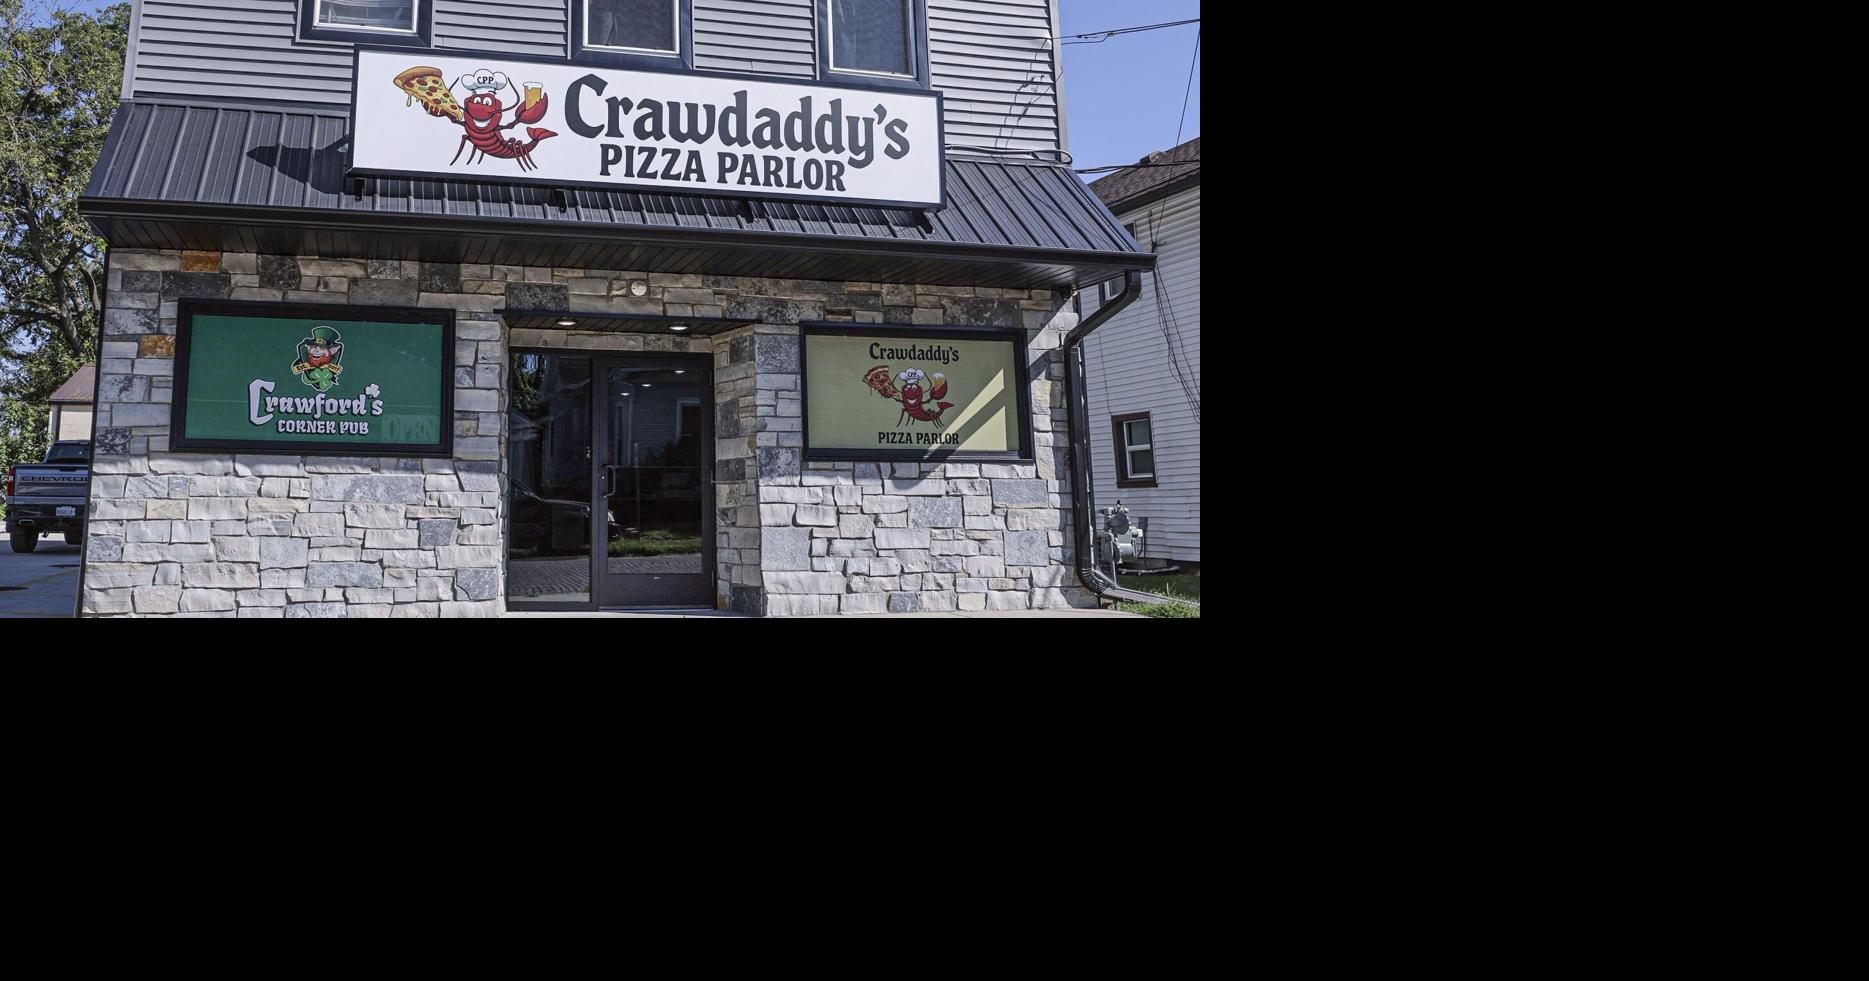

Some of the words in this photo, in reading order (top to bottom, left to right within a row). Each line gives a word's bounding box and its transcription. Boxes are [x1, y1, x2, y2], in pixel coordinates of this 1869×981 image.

[477, 76, 494, 84] CPP
[564, 73, 910, 168] Crawdaddy's
[599, 143, 706, 183] PIZZA
[716, 156, 847, 192] PARLOR
[869, 342, 959, 364] Crawdaddy's
[249, 379, 383, 425] Crawford's
[277, 419, 337, 434] CORNER
[339, 420, 369, 435] PUB
[878, 432, 913, 444] PIZZA
[916, 433, 959, 445] PARLOR
